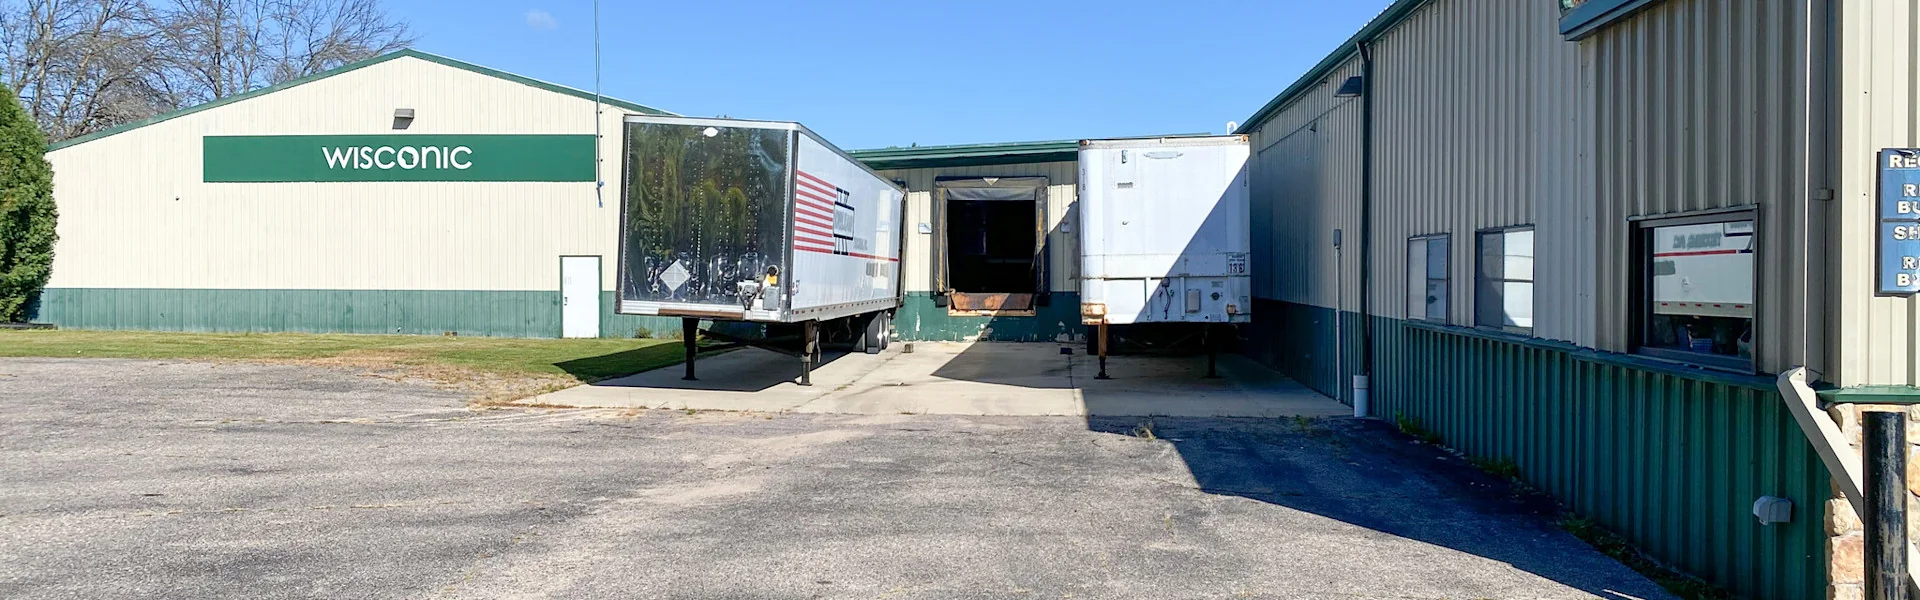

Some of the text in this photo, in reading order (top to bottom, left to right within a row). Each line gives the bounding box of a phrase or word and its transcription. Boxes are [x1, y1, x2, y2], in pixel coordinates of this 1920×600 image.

[321, 145, 473, 170] WISCONIC
[1889, 154, 1920, 168] RE
[1903, 184, 1920, 197] R
[1902, 256, 1920, 269] R
